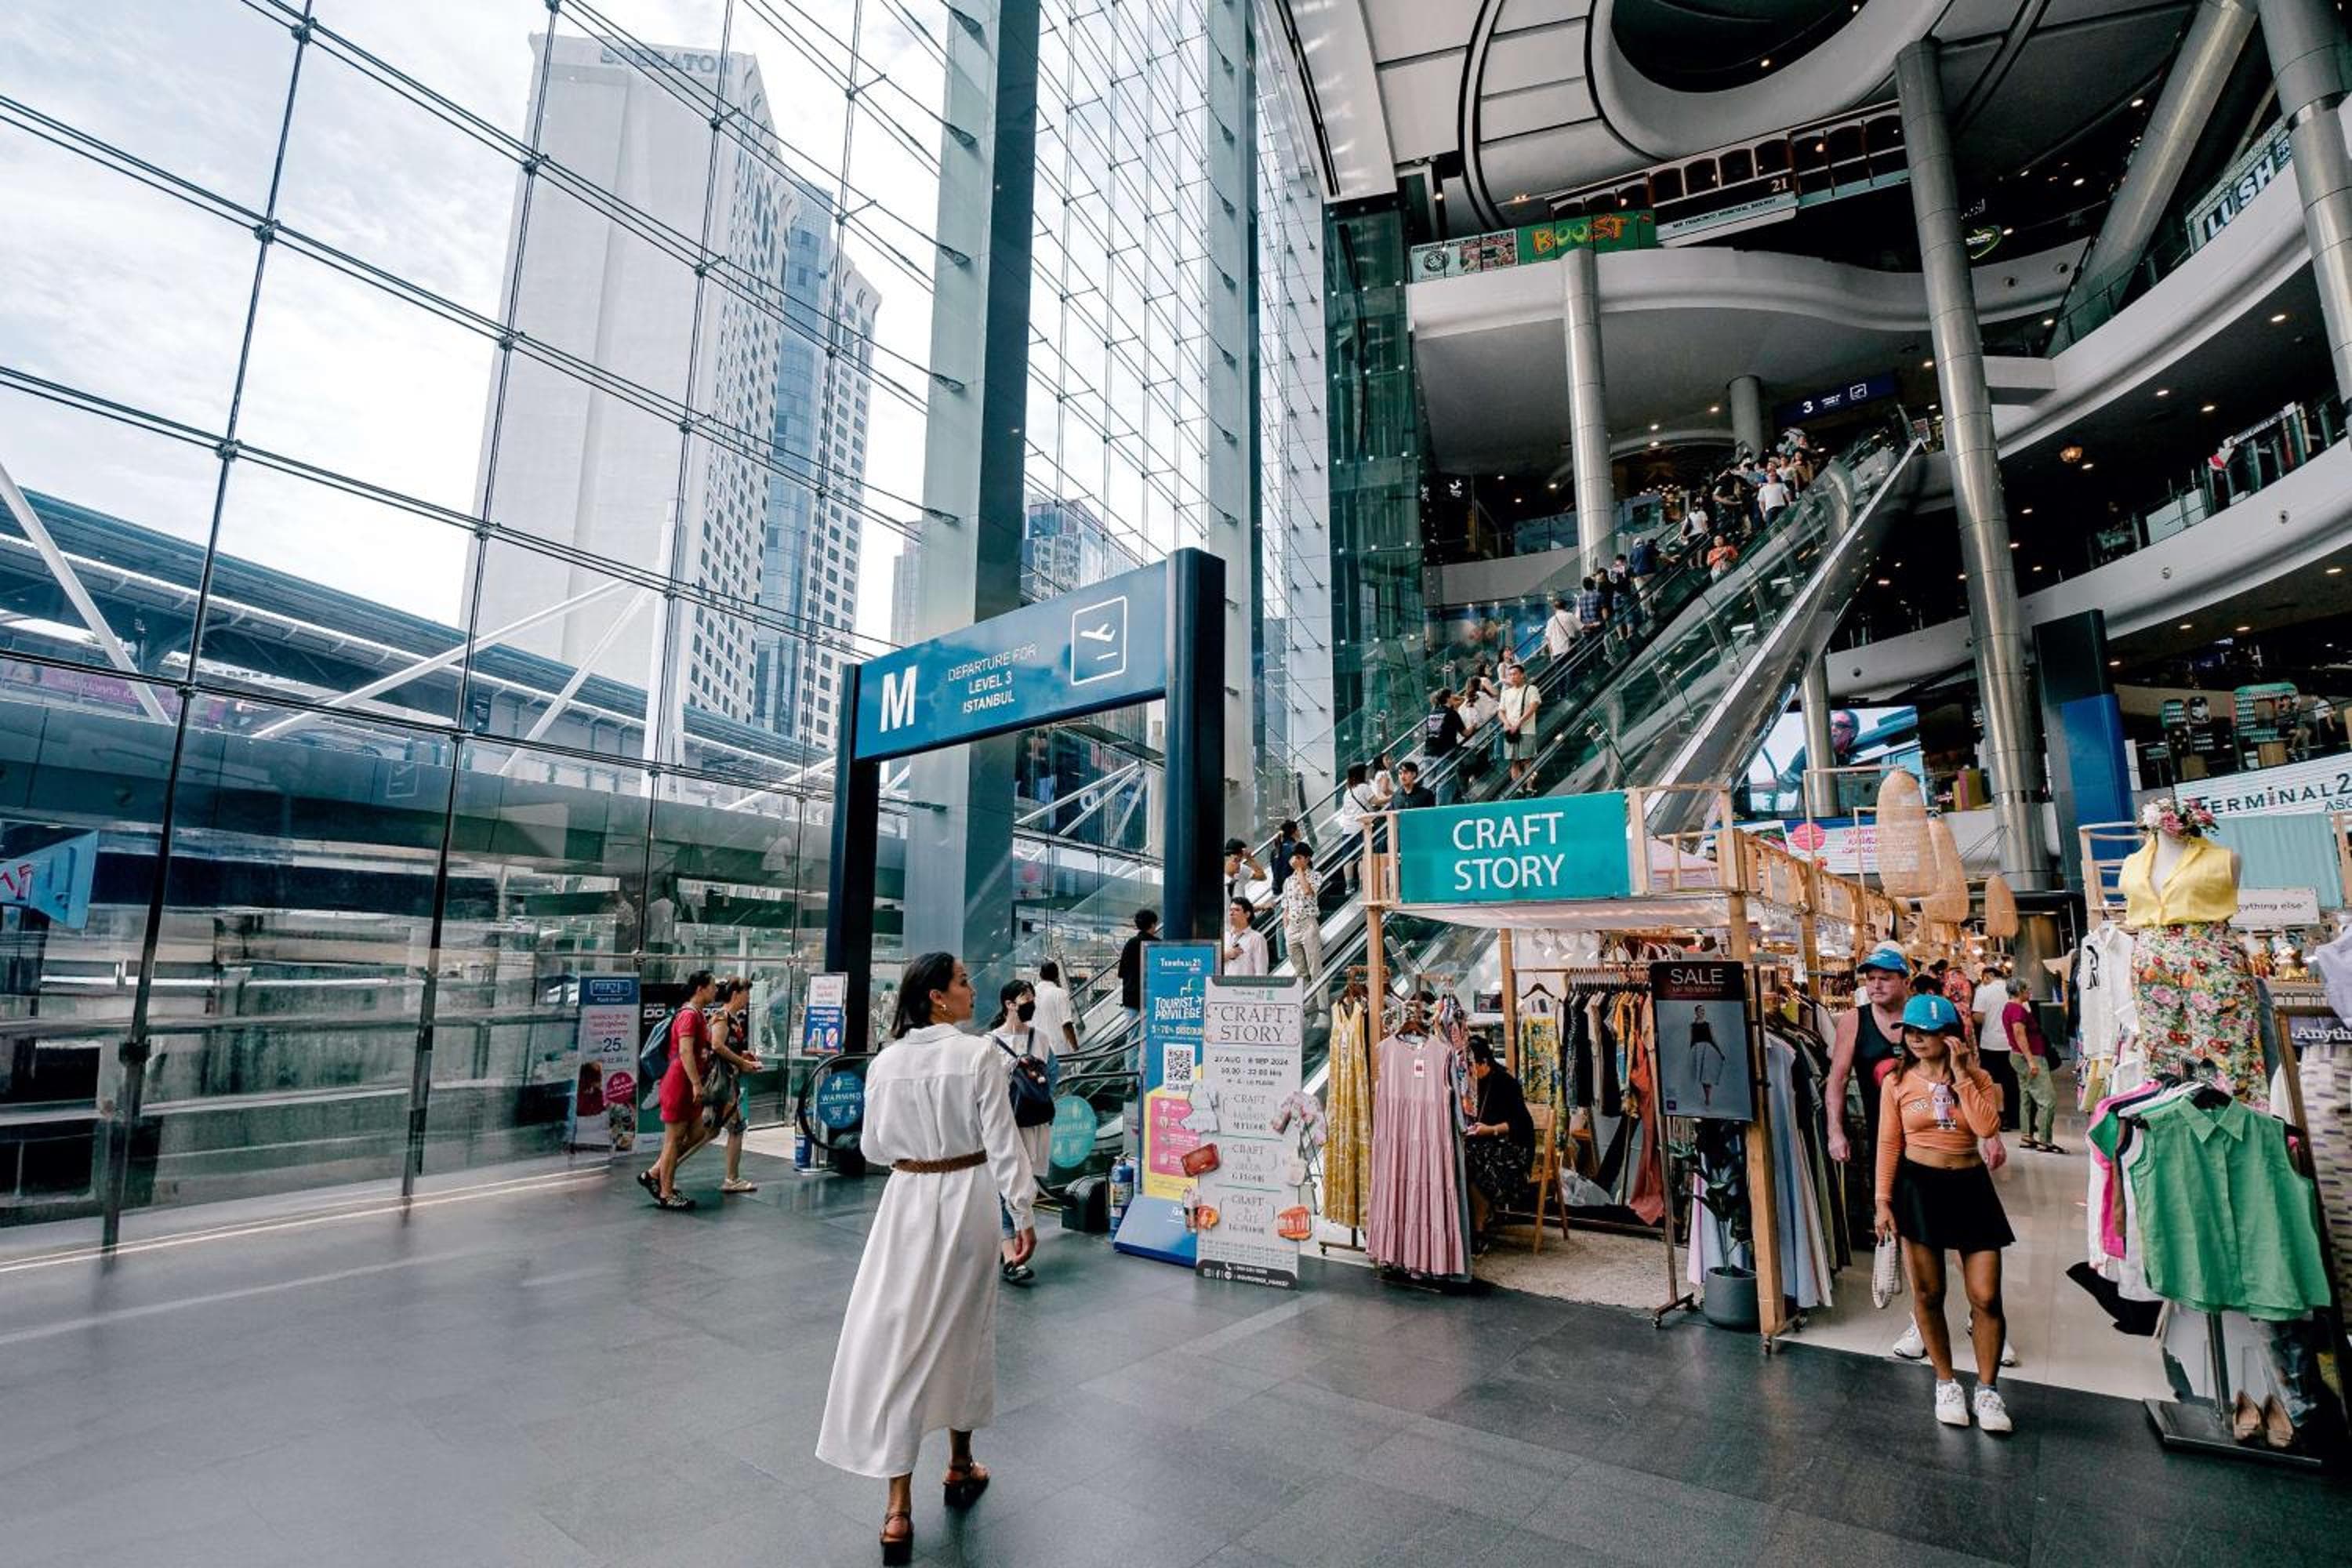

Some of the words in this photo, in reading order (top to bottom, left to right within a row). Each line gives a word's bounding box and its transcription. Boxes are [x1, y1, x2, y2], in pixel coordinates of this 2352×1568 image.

[1771, 177, 1788, 192] 21
[2207, 154, 2274, 238] LUSH
[1803, 401, 1813, 413] 3
[948, 652, 1011, 681] DEPARTURE
[1013, 644, 1036, 662] FOR
[968, 674, 1003, 694] LEVEL
[1005, 670, 1012, 684] 3
[879, 665, 918, 733] M
[963, 690, 1015, 713] ISTANBUL
[1453, 811, 1563, 851] CRAFT
[1454, 853, 1565, 891] STORY
[1671, 968, 1725, 984] SALE
[1155, 996, 1193, 1011] TOURIST
[1155, 1007, 1203, 1022] PRIVILEGE
[1221, 1005, 1286, 1023] CRAFT
[1221, 1025, 1284, 1042] STORY
[603, 1037, 622, 1052] 25
[1233, 1094, 1265, 1105] CRAFT
[1232, 1144, 1263, 1155] CRAFT
[1232, 1194, 1264, 1206] CRAFT
